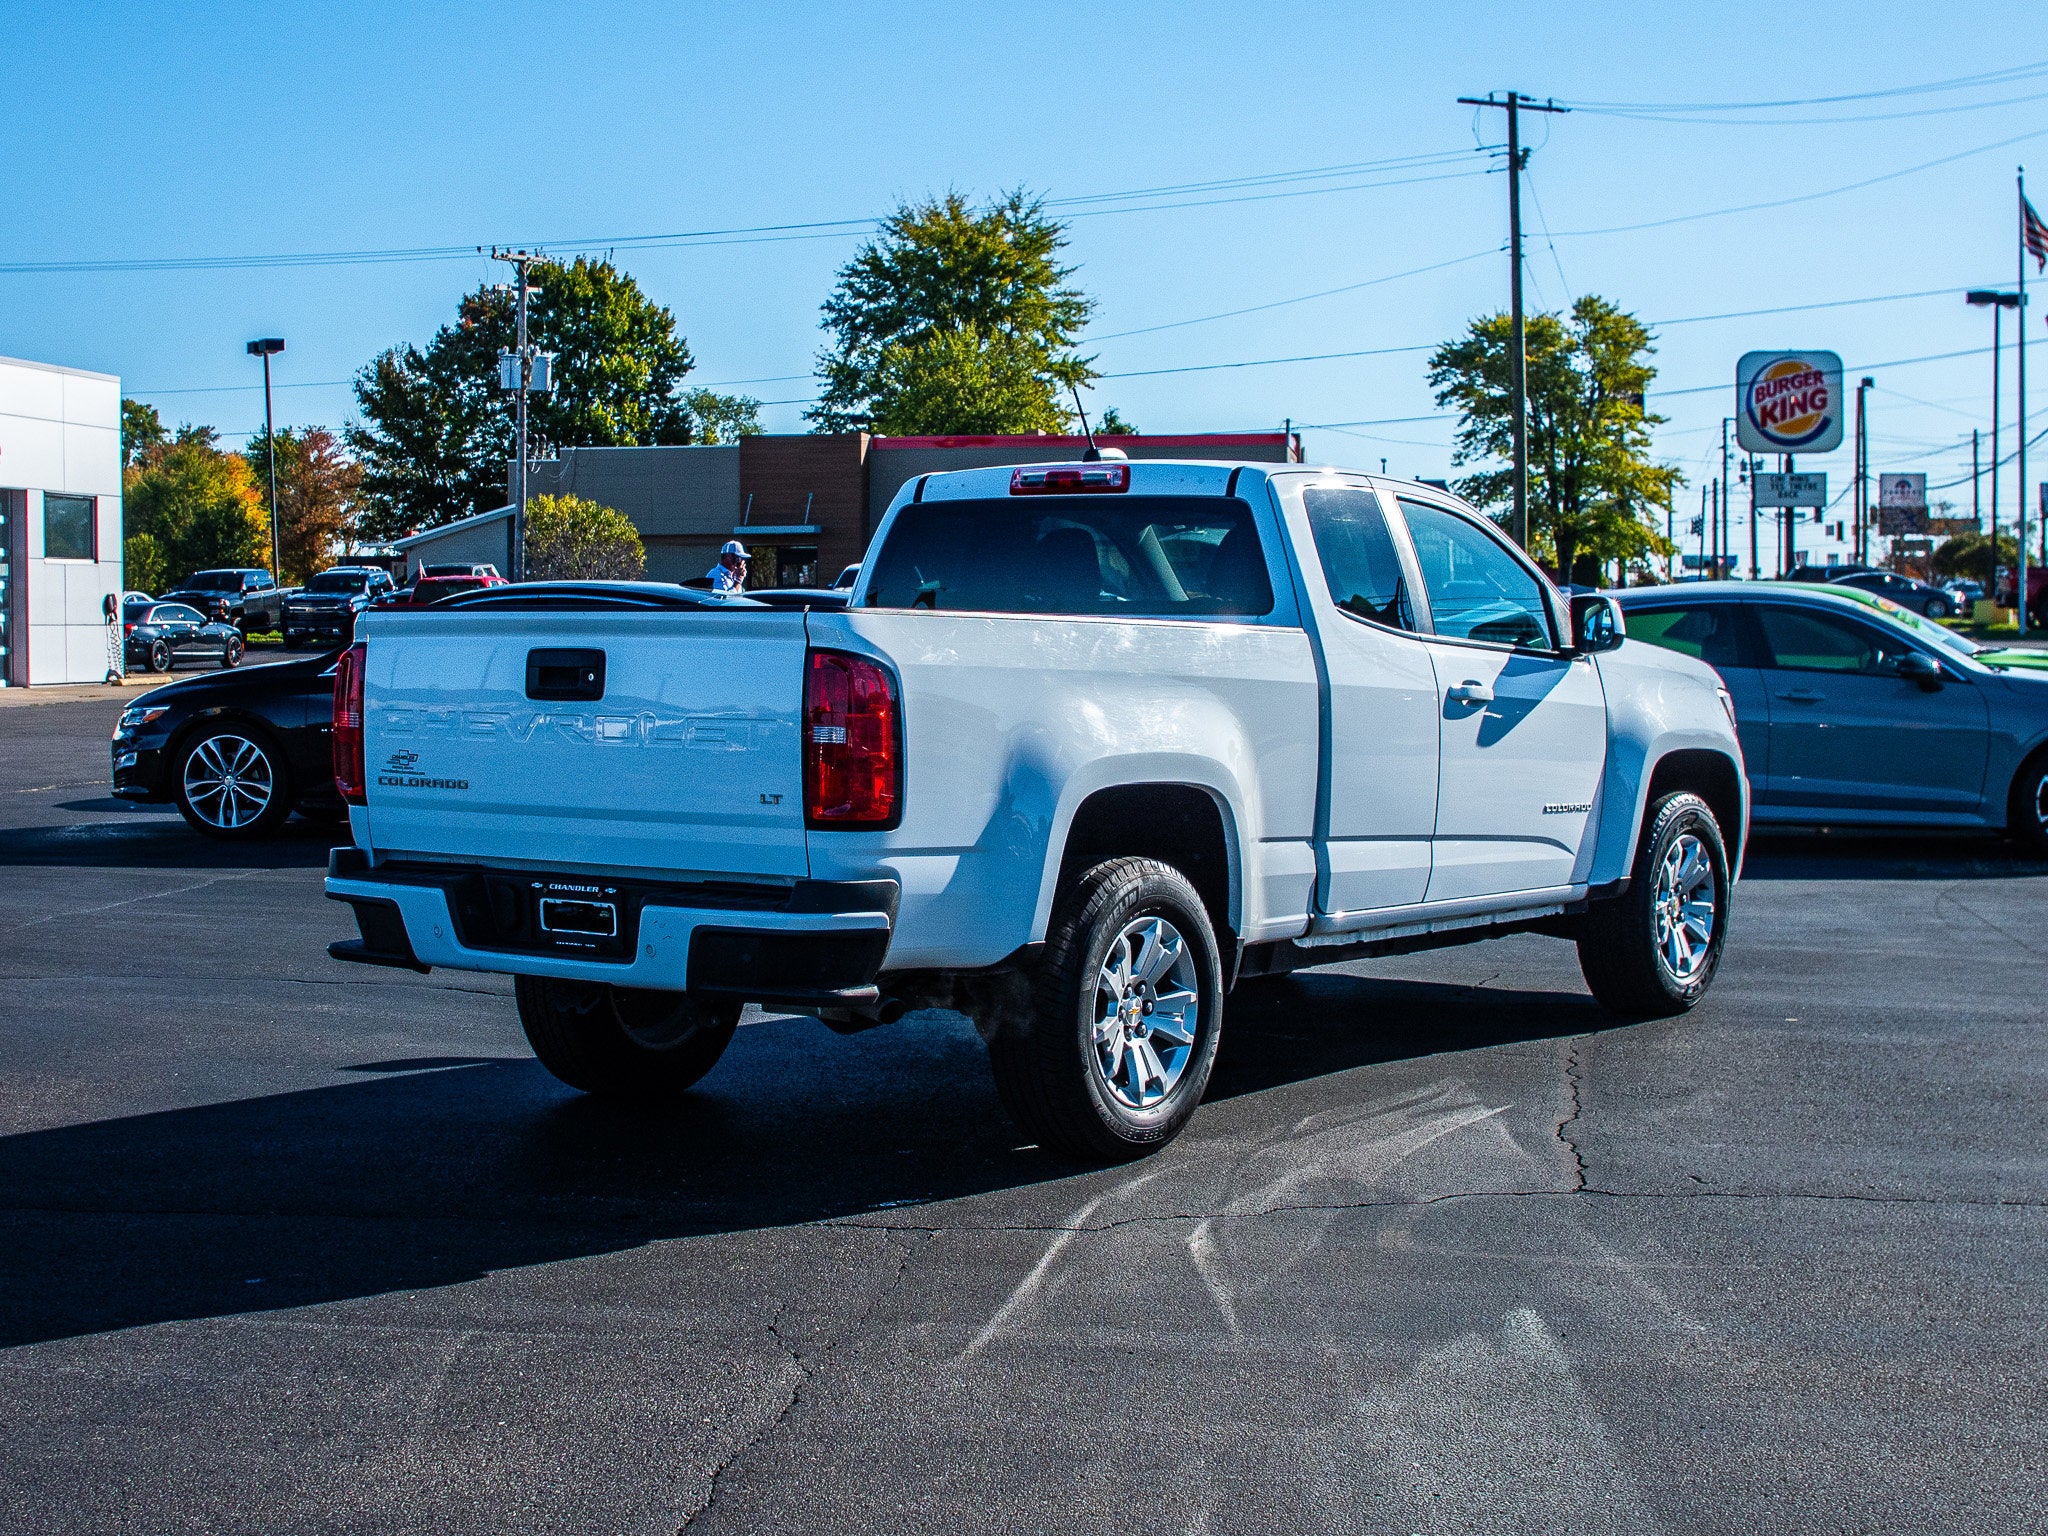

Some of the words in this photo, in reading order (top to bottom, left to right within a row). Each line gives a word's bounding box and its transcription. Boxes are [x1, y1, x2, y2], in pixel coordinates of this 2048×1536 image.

[1754, 370, 1824, 404] BURGER
[1760, 388, 1828, 428] KING
[380, 708, 779, 750] CHEVROLET
[378, 776, 469, 790] COLORADO
[760, 793, 784, 805] LT
[1543, 802, 1592, 814] COLORADO
[548, 883, 600, 893] CHANDLER
